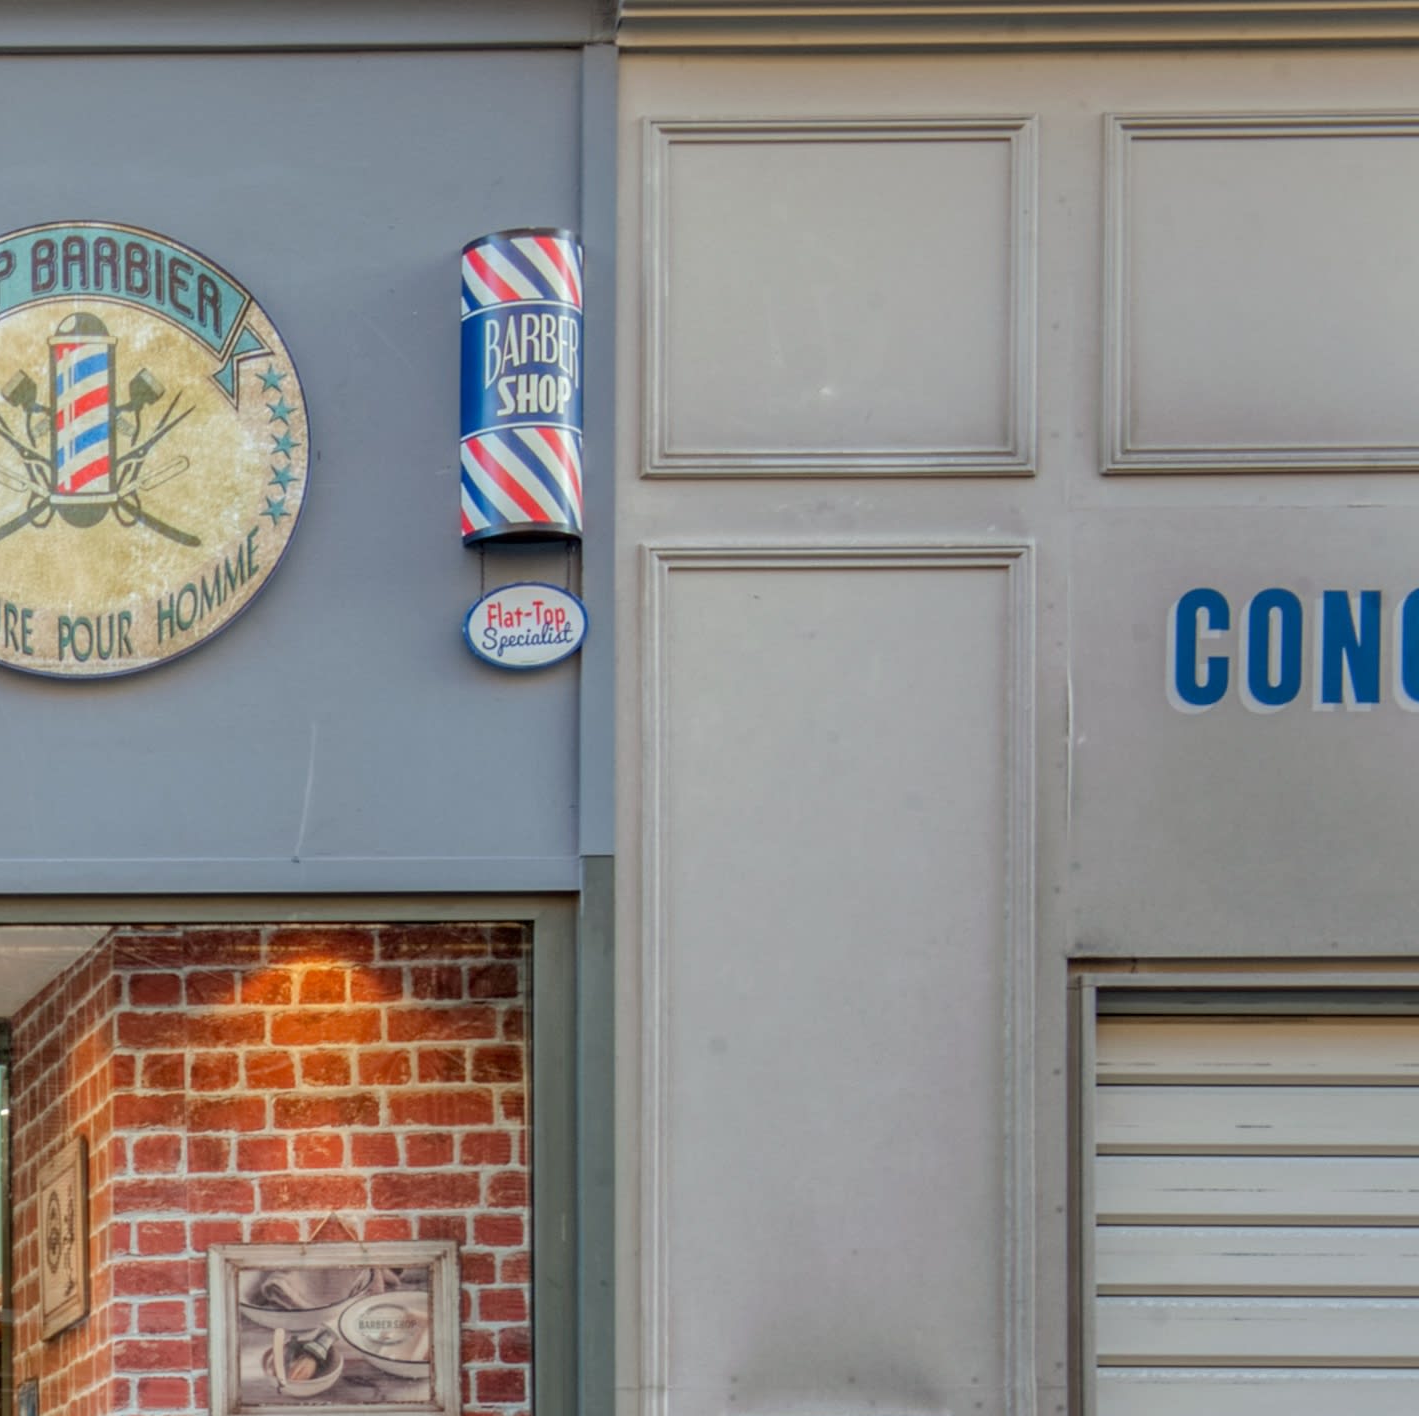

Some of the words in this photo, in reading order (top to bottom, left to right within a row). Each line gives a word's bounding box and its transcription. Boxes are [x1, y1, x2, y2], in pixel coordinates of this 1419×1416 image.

[31, 235, 223, 337] BARBIER
[484, 312, 580, 391] BARBER
[497, 375, 572, 417] SHOP
[57, 610, 133, 662] POUR
[157, 527, 261, 645] HOMME
[487, 601, 566, 629] Flat-Top
[481, 621, 575, 658] Specialist
